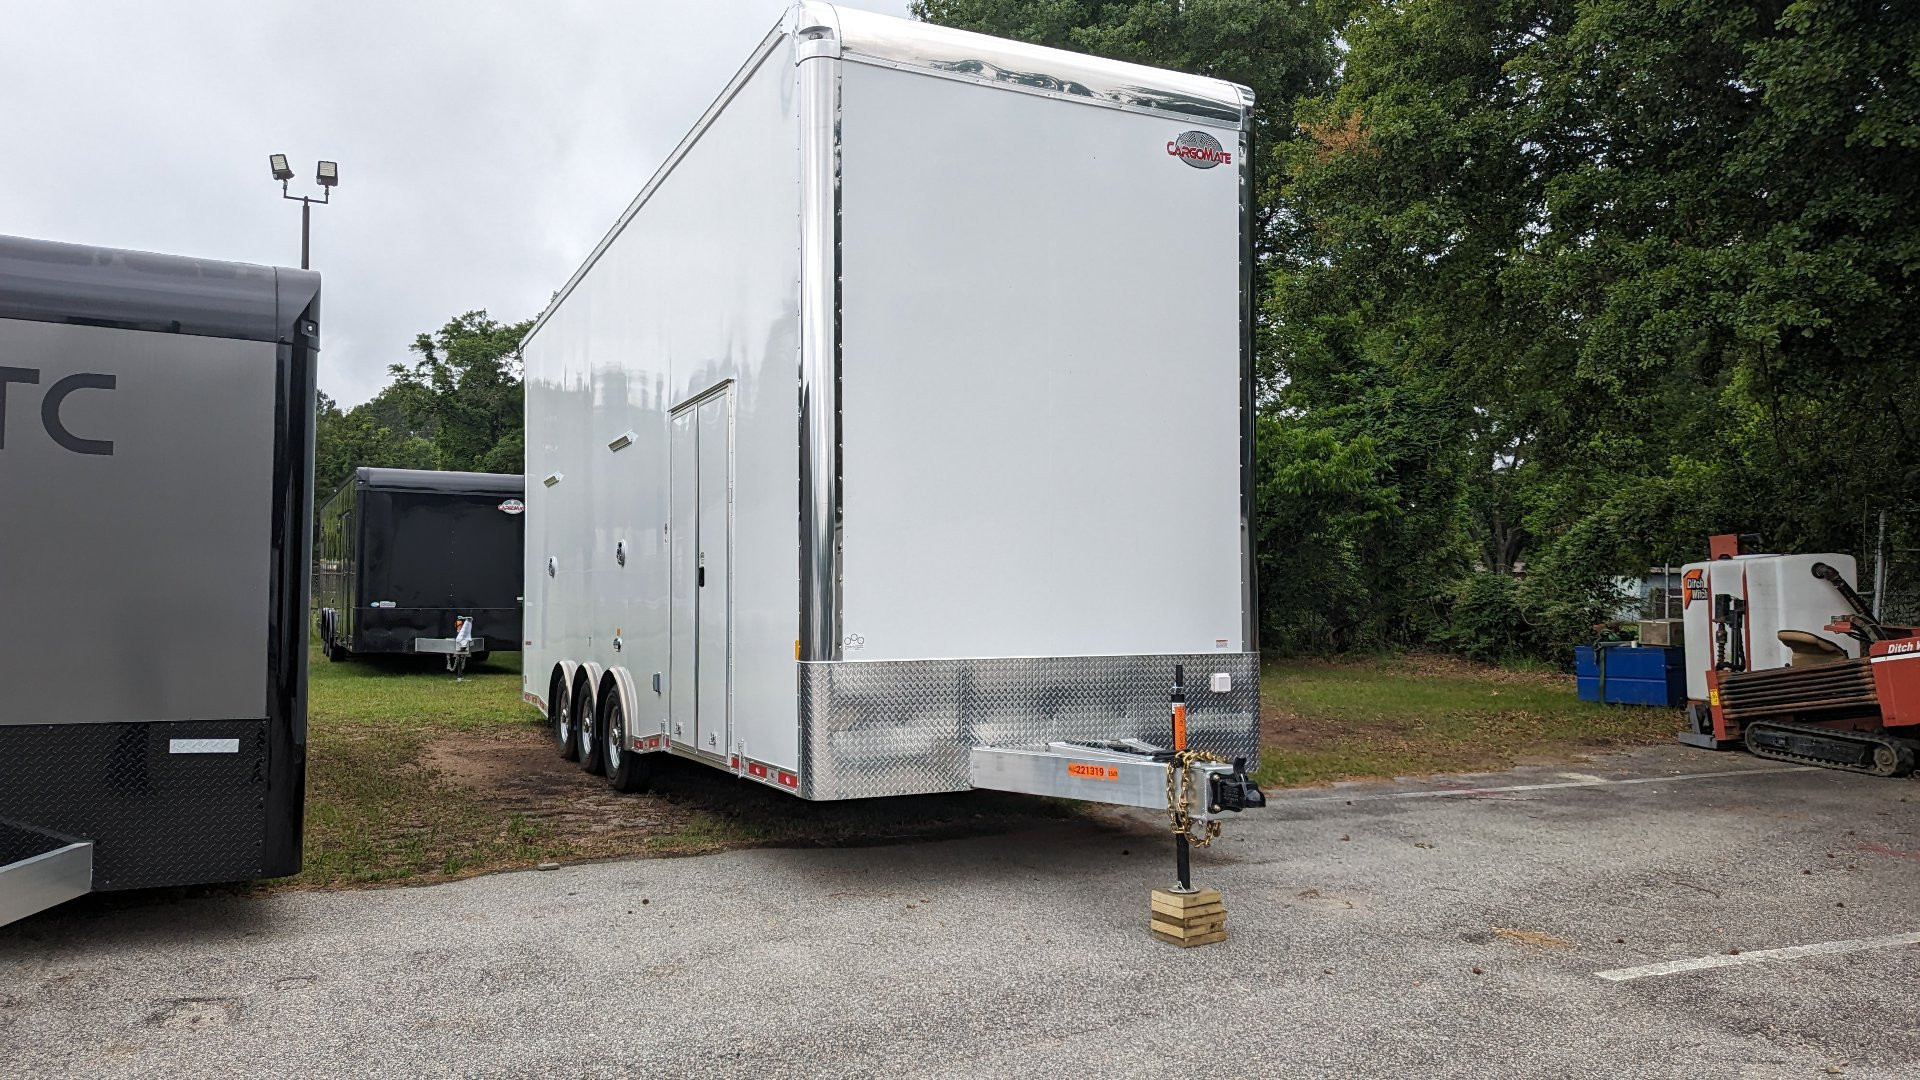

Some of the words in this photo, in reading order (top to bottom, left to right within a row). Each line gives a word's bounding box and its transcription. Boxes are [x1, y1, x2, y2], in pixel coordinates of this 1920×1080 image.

[1687, 578, 1704, 589] Ditch
[1887, 641, 1914, 654] Ditch
[1076, 765, 1105, 777] 221319
